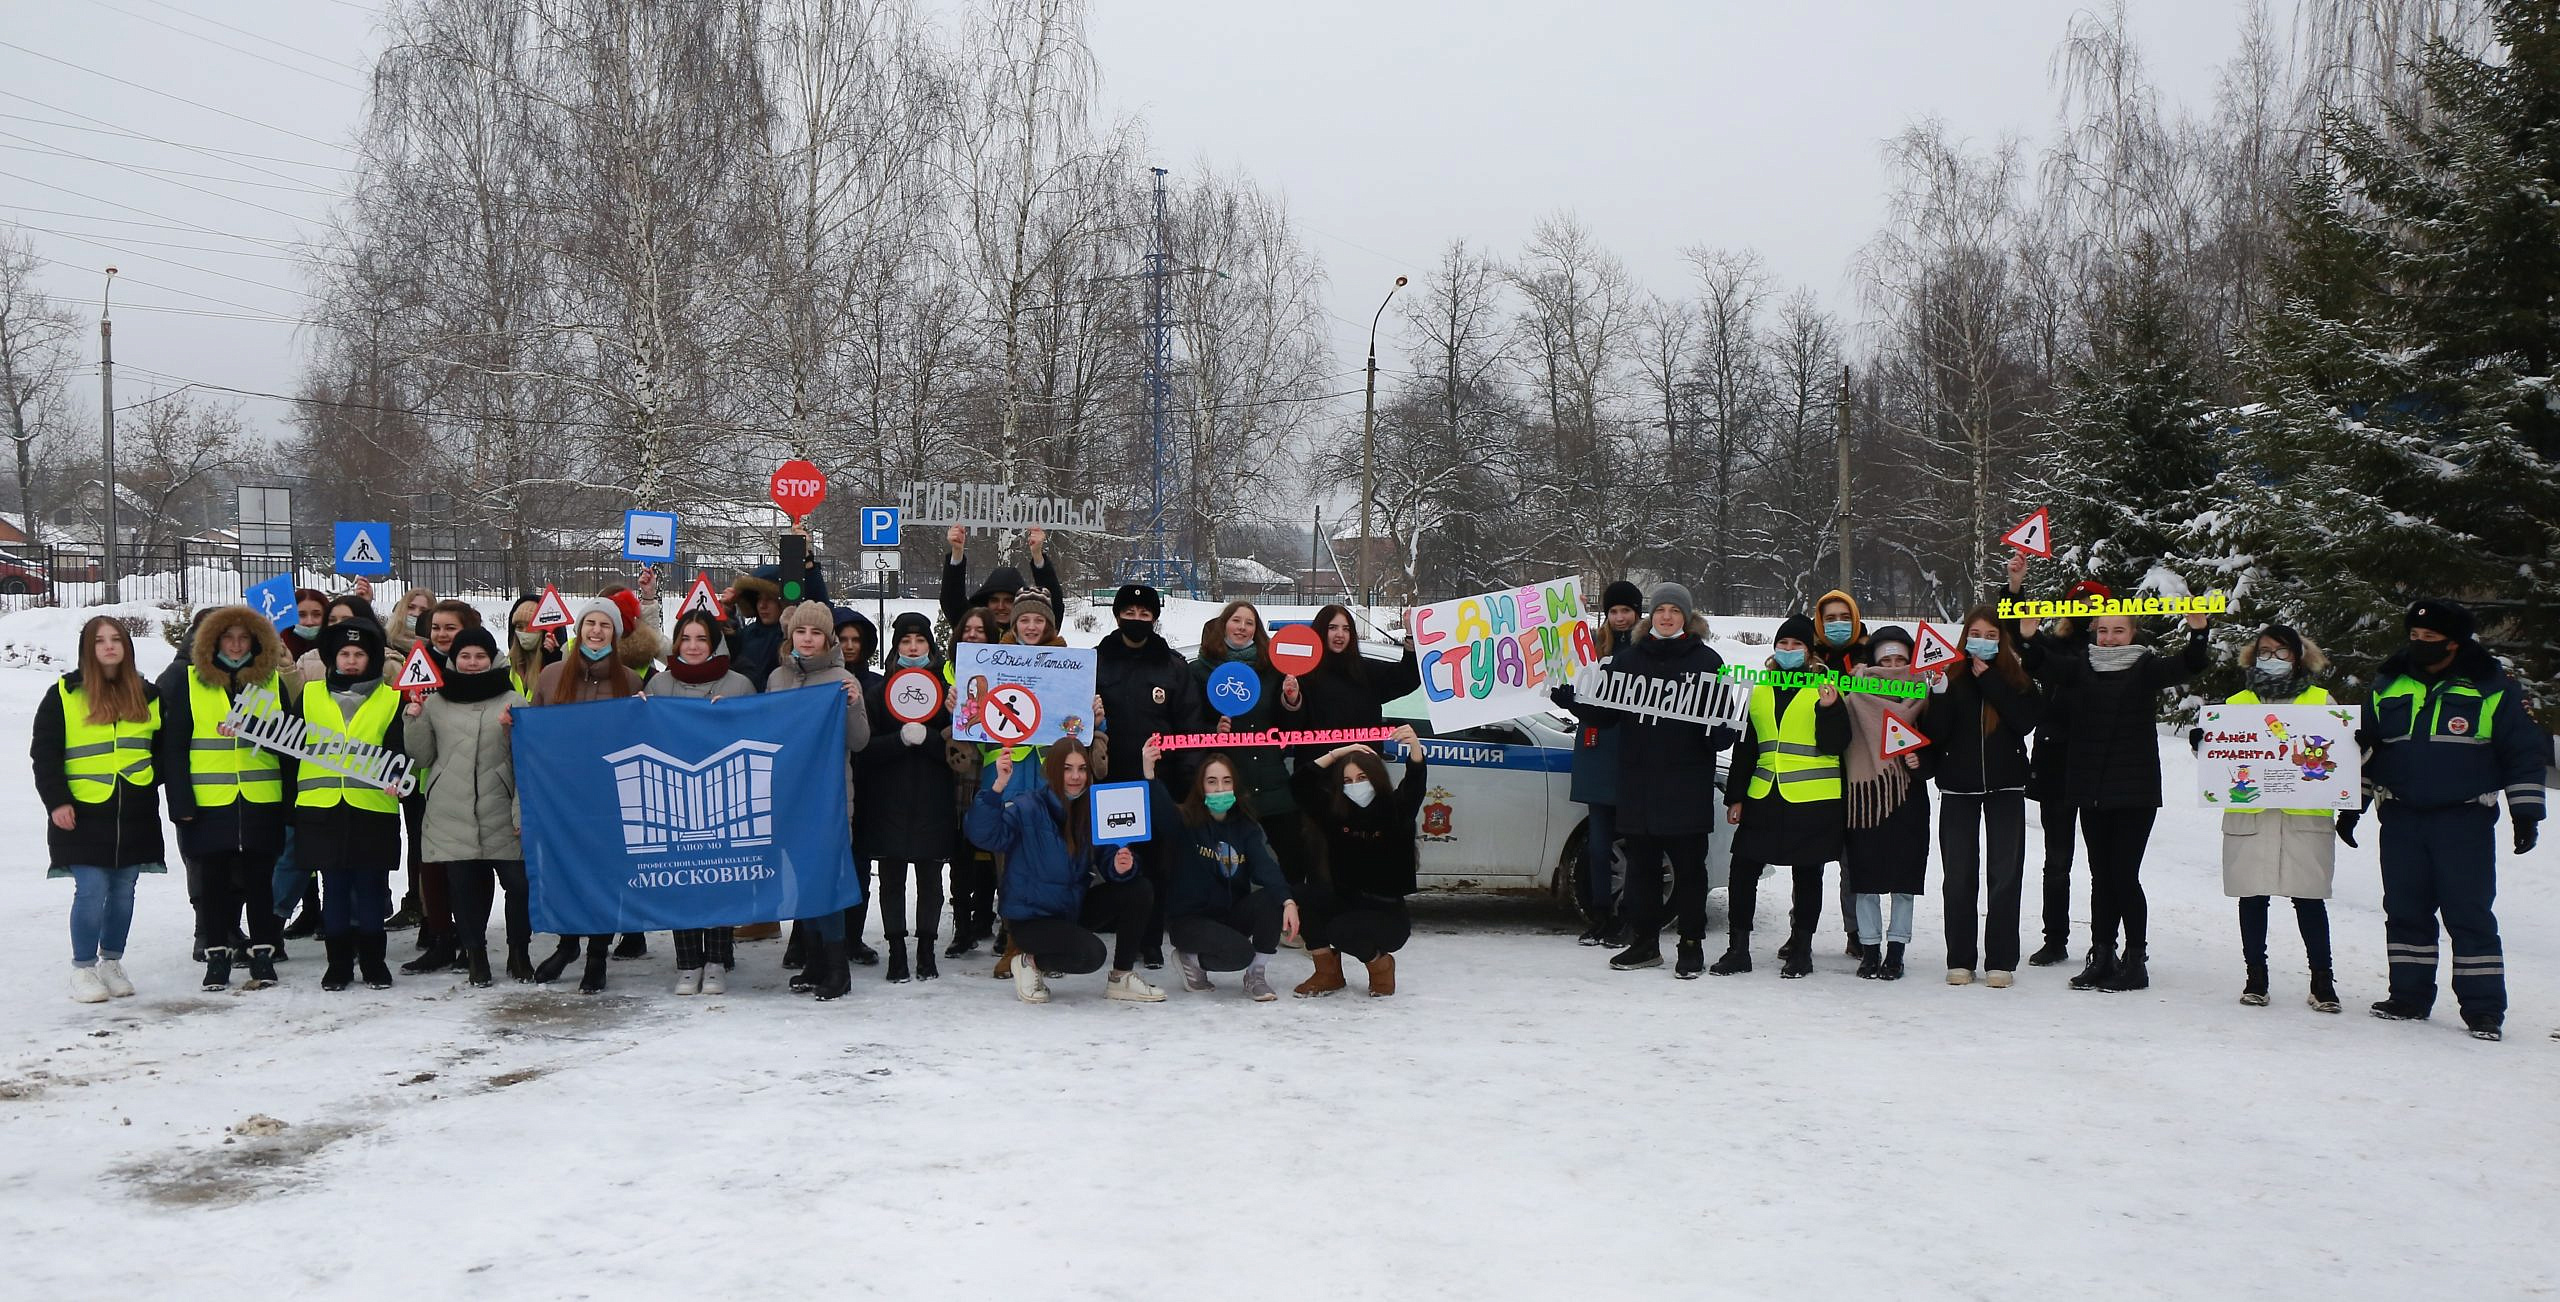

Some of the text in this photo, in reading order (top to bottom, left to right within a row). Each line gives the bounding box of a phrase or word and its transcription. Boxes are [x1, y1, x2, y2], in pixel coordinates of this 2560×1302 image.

[777, 479, 820, 497] STOP
[900, 481, 1106, 537] #ГИБДДПодольск
[872, 510, 893, 541] P
[1997, 589, 2226, 619] #станьЗаметней
[1416, 608, 1446, 646] С
[976, 648, 991, 664] С
[1421, 620, 1597, 703] СТУДЕНТА
[226, 682, 416, 798] #Пристегнись
[1151, 725, 1397, 751] #движениеСуважением
[627, 864, 776, 889] «МОСКОВИЯ»
[637, 858, 723, 870] ПРОФЕССИОНАЛЬНЫЙ
